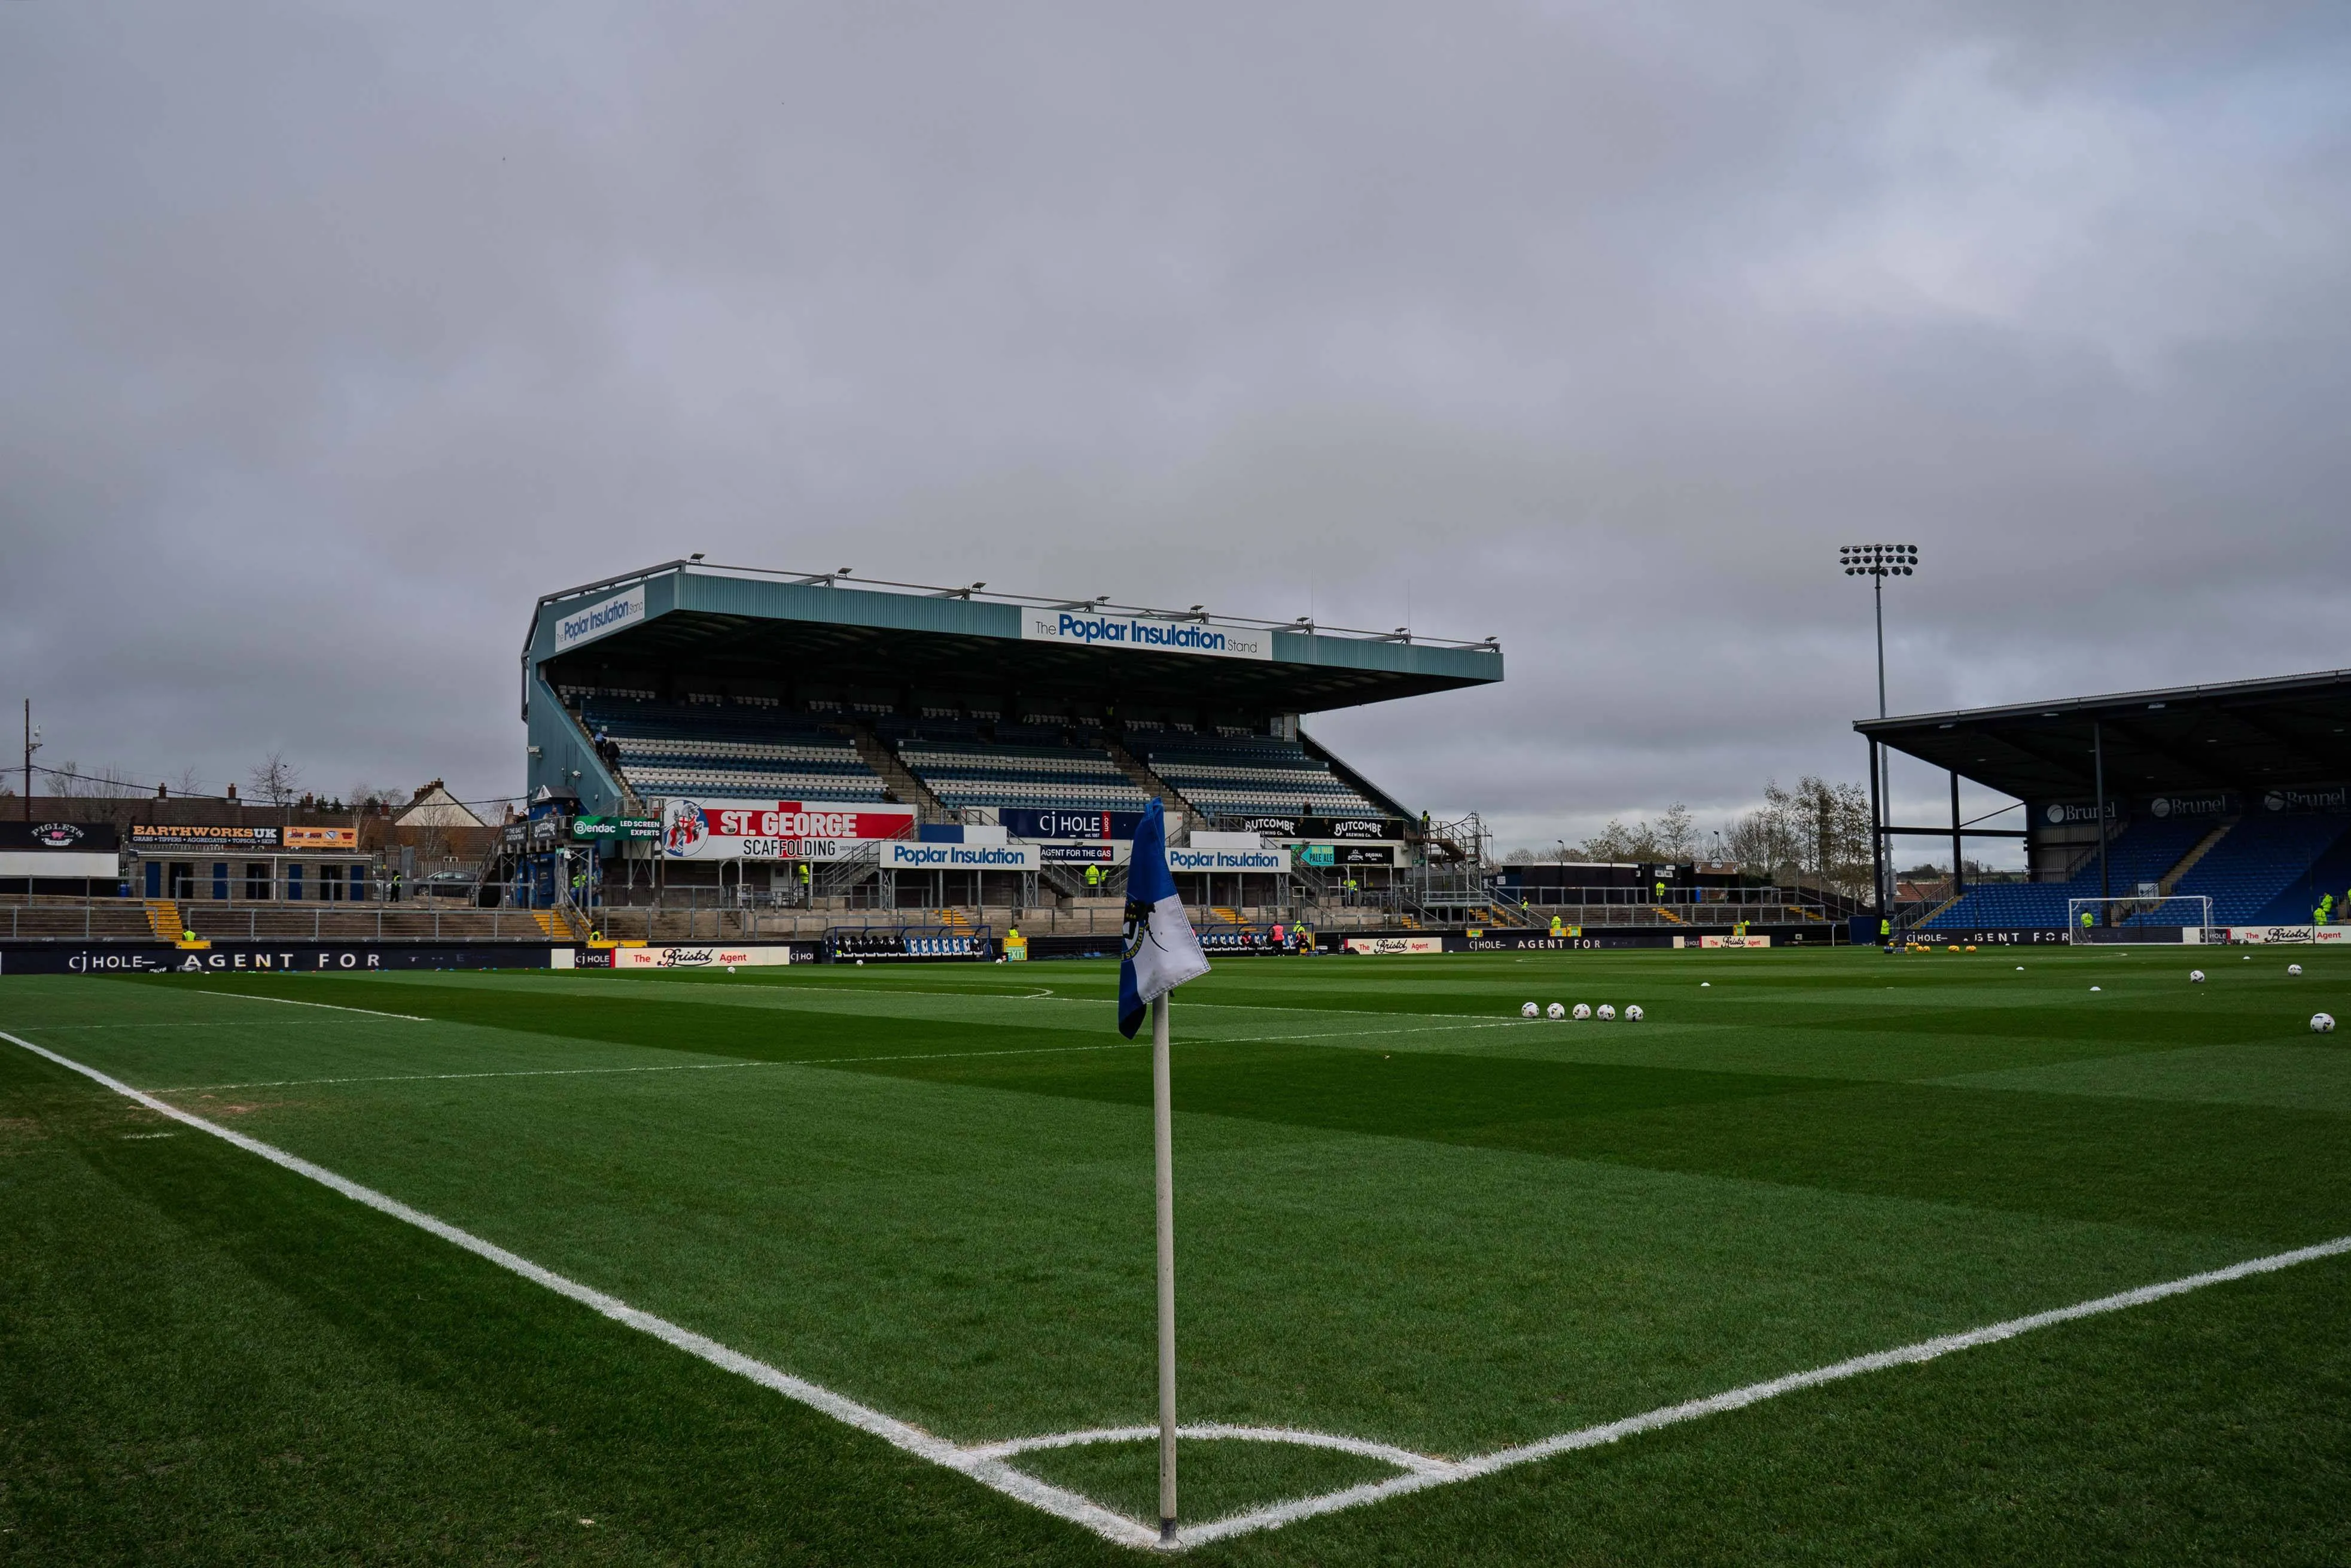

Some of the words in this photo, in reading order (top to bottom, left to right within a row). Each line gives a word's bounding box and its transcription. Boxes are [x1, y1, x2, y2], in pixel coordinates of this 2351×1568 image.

[564, 616, 589, 641] Poplar
[590, 600, 629, 631] Insulation
[629, 602, 643, 615] Stand
[1036, 621, 1056, 636] The
[1059, 614, 1128, 643] Poplar
[1131, 620, 1225, 650] Insulation
[1228, 639, 1257, 653] Stand
[2172, 794, 2226, 814] Brunel
[2286, 787, 2345, 808] Brunel
[720, 811, 756, 835] ST.
[762, 812, 857, 837] GEORGE
[1061, 816, 1100, 831] HOLE
[1245, 818, 1295, 836] BUTCOMBE
[1334, 821, 1382, 838] BUTCOMBE
[743, 839, 836, 855] SCAFFOLDING
[894, 845, 948, 866] Poplar
[951, 847, 1025, 864] Insulation
[1041, 848, 1064, 857] AGENT
[1170, 851, 1215, 869] Poplar
[1217, 852, 1279, 867] Insulation
[1310, 854, 1322, 862] PALE
[1323, 854, 1333, 862] ALE
[1518, 939, 1564, 949] AGENT
[1575, 939, 1601, 949] FOR
[1721, 936, 1746, 948] Bristol
[2264, 928, 2313, 943] Bristol
[1374, 939, 1407, 954] Bristol
[184, 954, 294, 967] AGENT
[319, 953, 380, 967] FOR
[634, 954, 651, 963] The
[657, 948, 713, 966] Bristol
[720, 954, 747, 962] Agent
